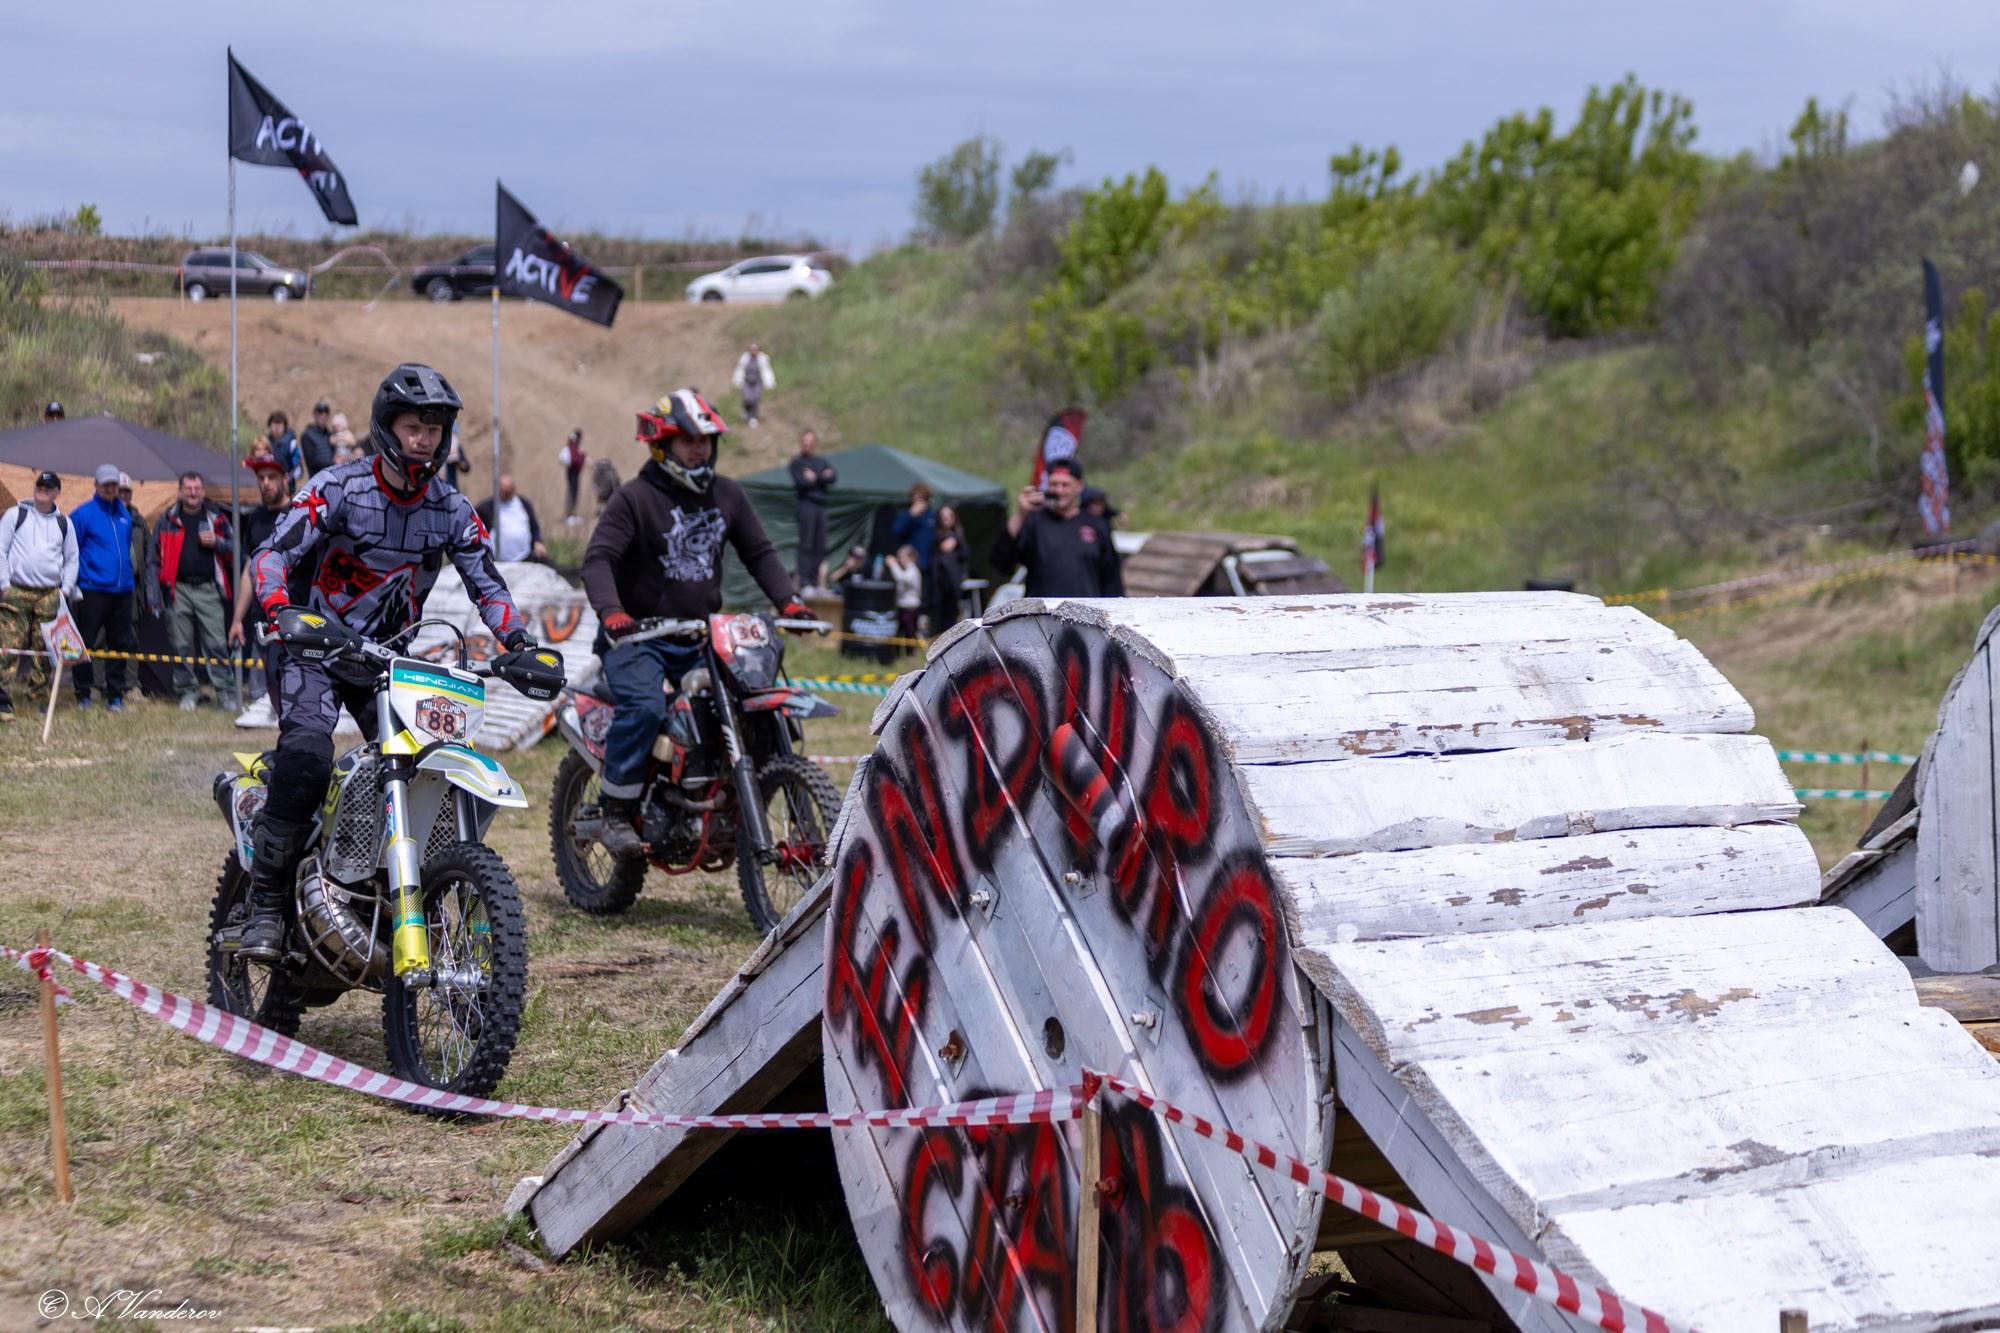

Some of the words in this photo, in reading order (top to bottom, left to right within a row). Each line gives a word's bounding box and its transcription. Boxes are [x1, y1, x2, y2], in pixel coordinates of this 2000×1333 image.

[505, 247, 599, 304] ACTIVE
[738, 624, 766, 640] 36
[422, 700, 438, 711] HILL
[440, 702, 461, 715] CLIMB
[428, 710, 454, 734] 88
[826, 626, 1284, 1112] ENDURO
